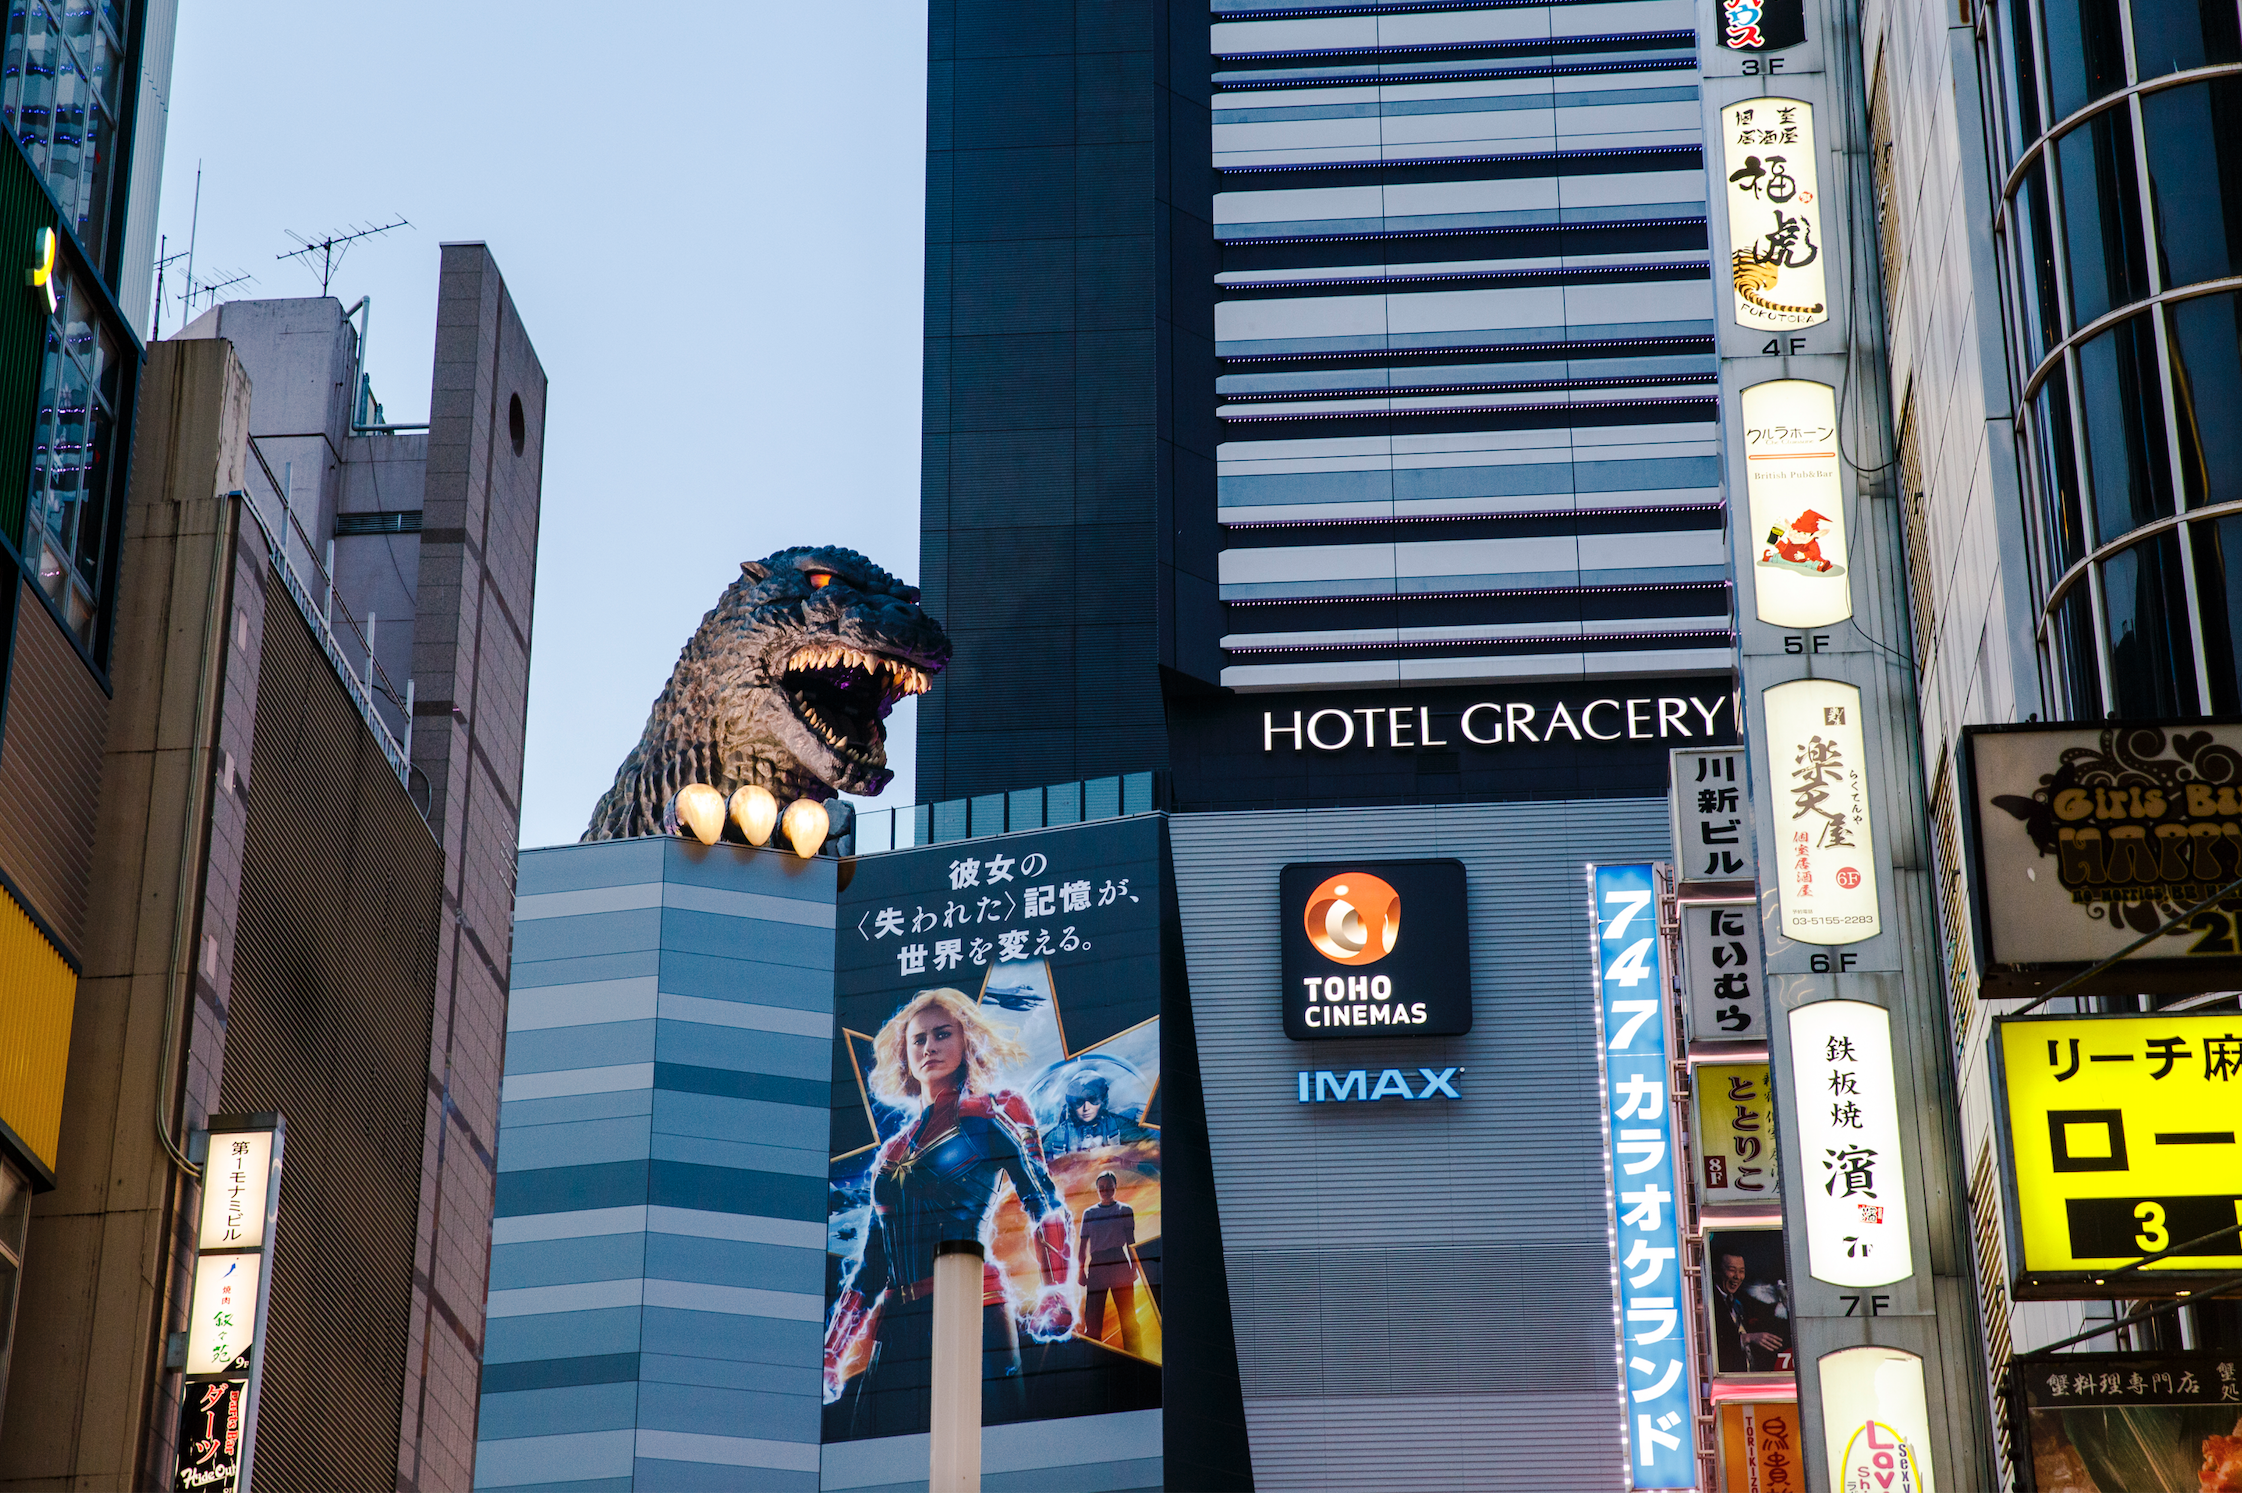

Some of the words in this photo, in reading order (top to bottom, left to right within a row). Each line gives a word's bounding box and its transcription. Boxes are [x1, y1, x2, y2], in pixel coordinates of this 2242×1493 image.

[1736, 126, 1798, 145] 居酒屋
[1729, 155, 1818, 269] 福虎
[1740, 303, 1815, 324] FUKUTORA
[1746, 426, 1834, 445] クルラホーン
[1754, 471, 1787, 480] British
[1263, 705, 1448, 752] HOTEL
[1460, 696, 1727, 743] GRACERY
[1790, 735, 1857, 850] 楽天屋
[1849, 769, 1863, 825] らくてんや
[2053, 785, 2168, 822] Girls
[1695, 756, 1744, 875] 川新ビル
[949, 853, 1048, 891] 彼女の
[1793, 830, 1815, 898] 個室居酒屋
[1836, 870, 1861, 887] 6F
[1792, 915, 1874, 926] 03-5155-2283
[2186, 909, 2242, 956] 2
[897, 926, 1092, 977] 世界を変える。
[1710, 910, 1752, 1032] にいむら
[1303, 974, 1392, 1002] TOHO
[1304, 1002, 1428, 1028] CINEMAS
[1298, 1066, 1462, 1102] IMAX
[1825, 1035, 1864, 1130] 鉄板焼
[1728, 1075, 1765, 1192] ととりこ
[1708, 1158, 1723, 1186] 8F
[1822, 1143, 1879, 1199] 濱
[1842, 1235, 1874, 1258] 7F
[221, 1285, 232, 1305] 焼肉
[211, 1311, 234, 1364] 叙々苑
[235, 1356, 249, 1370] 9F
[200, 1383, 229, 1465] ダーツ
[227, 1390, 240, 1430] Darts
[224, 1430, 239, 1456] Bar
[1762, 1416, 1794, 1493] 鳥貴
[1865, 1420, 1895, 1493] Lav
[1857, 1466, 1871, 1493] Sh
